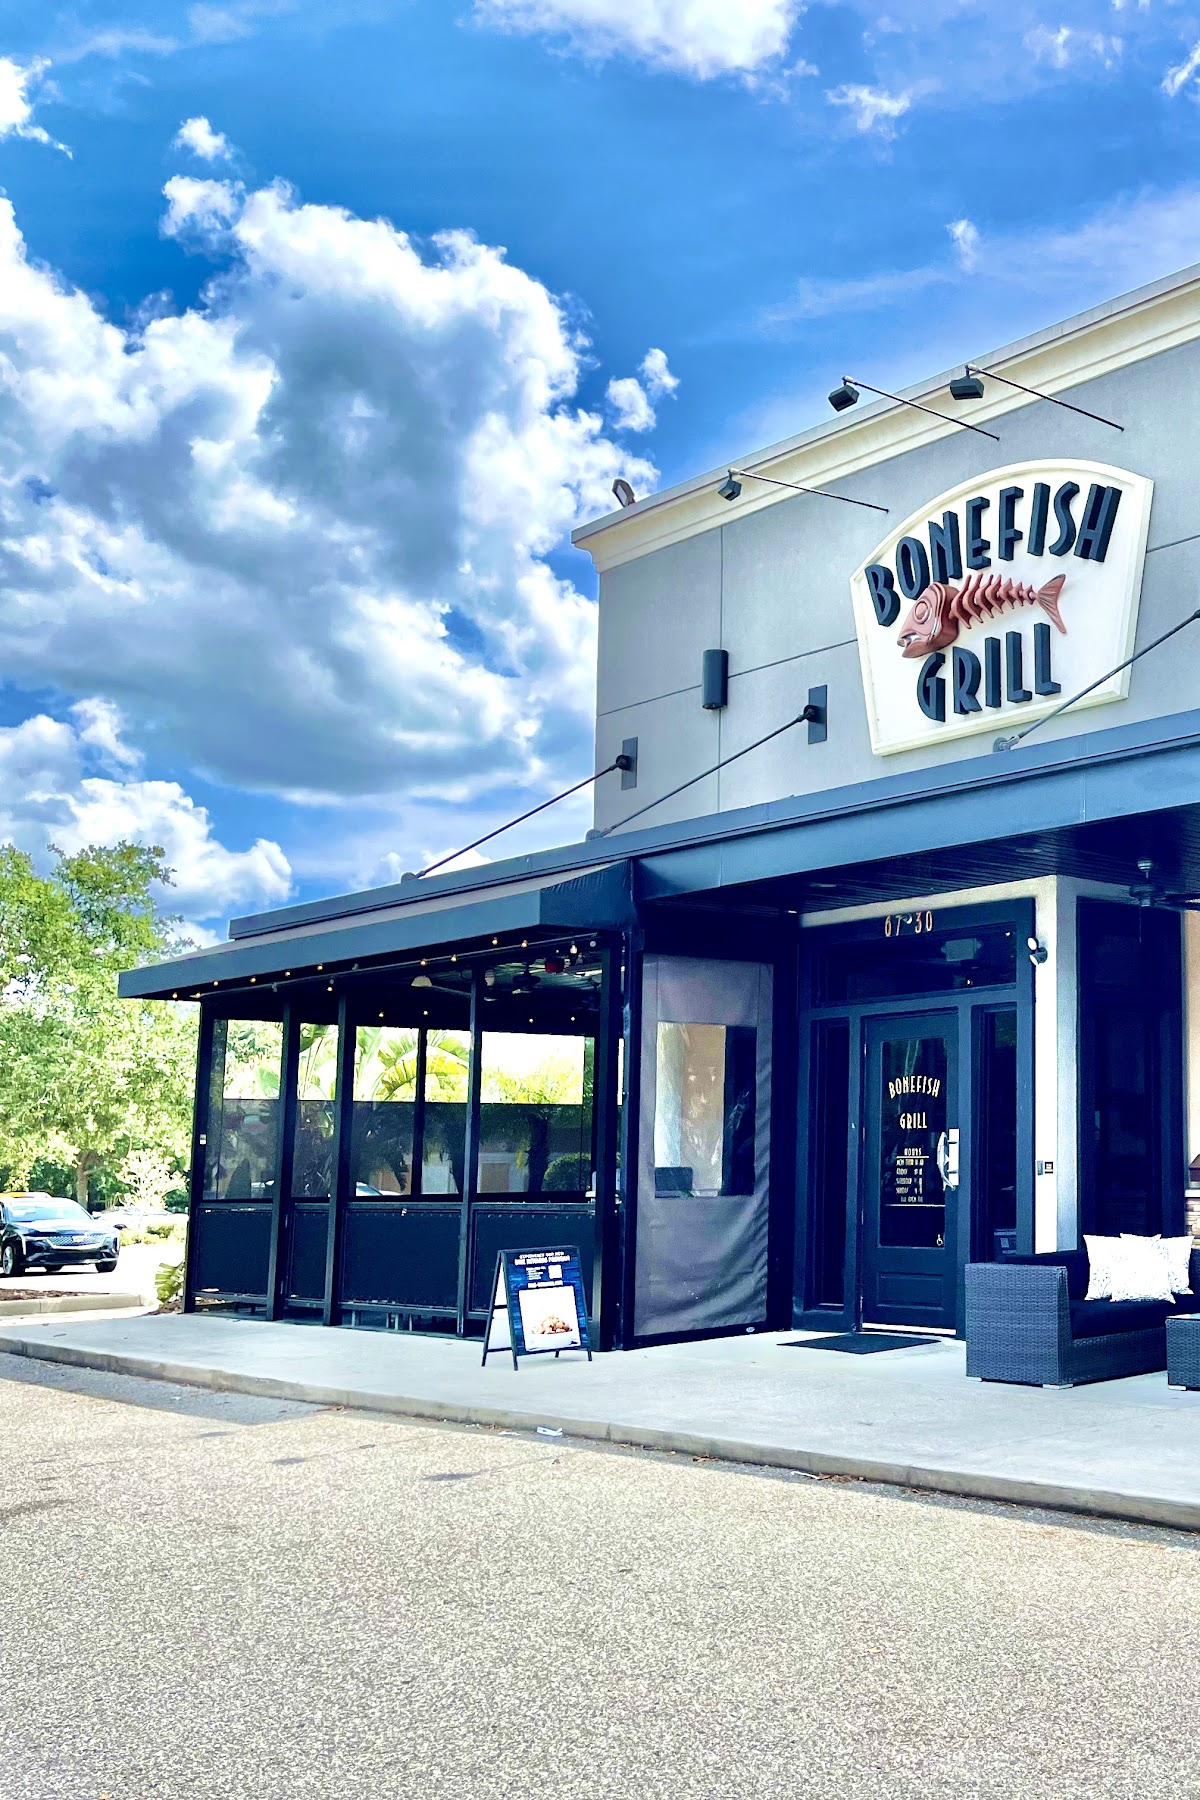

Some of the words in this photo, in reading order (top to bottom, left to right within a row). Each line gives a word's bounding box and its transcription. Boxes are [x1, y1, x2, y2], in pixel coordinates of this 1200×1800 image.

[865, 481, 1122, 627] BONEFISH
[917, 622, 1061, 722] GRILL
[888, 1075, 941, 1099] BONEFISH
[900, 1111, 928, 1129] GRILL
